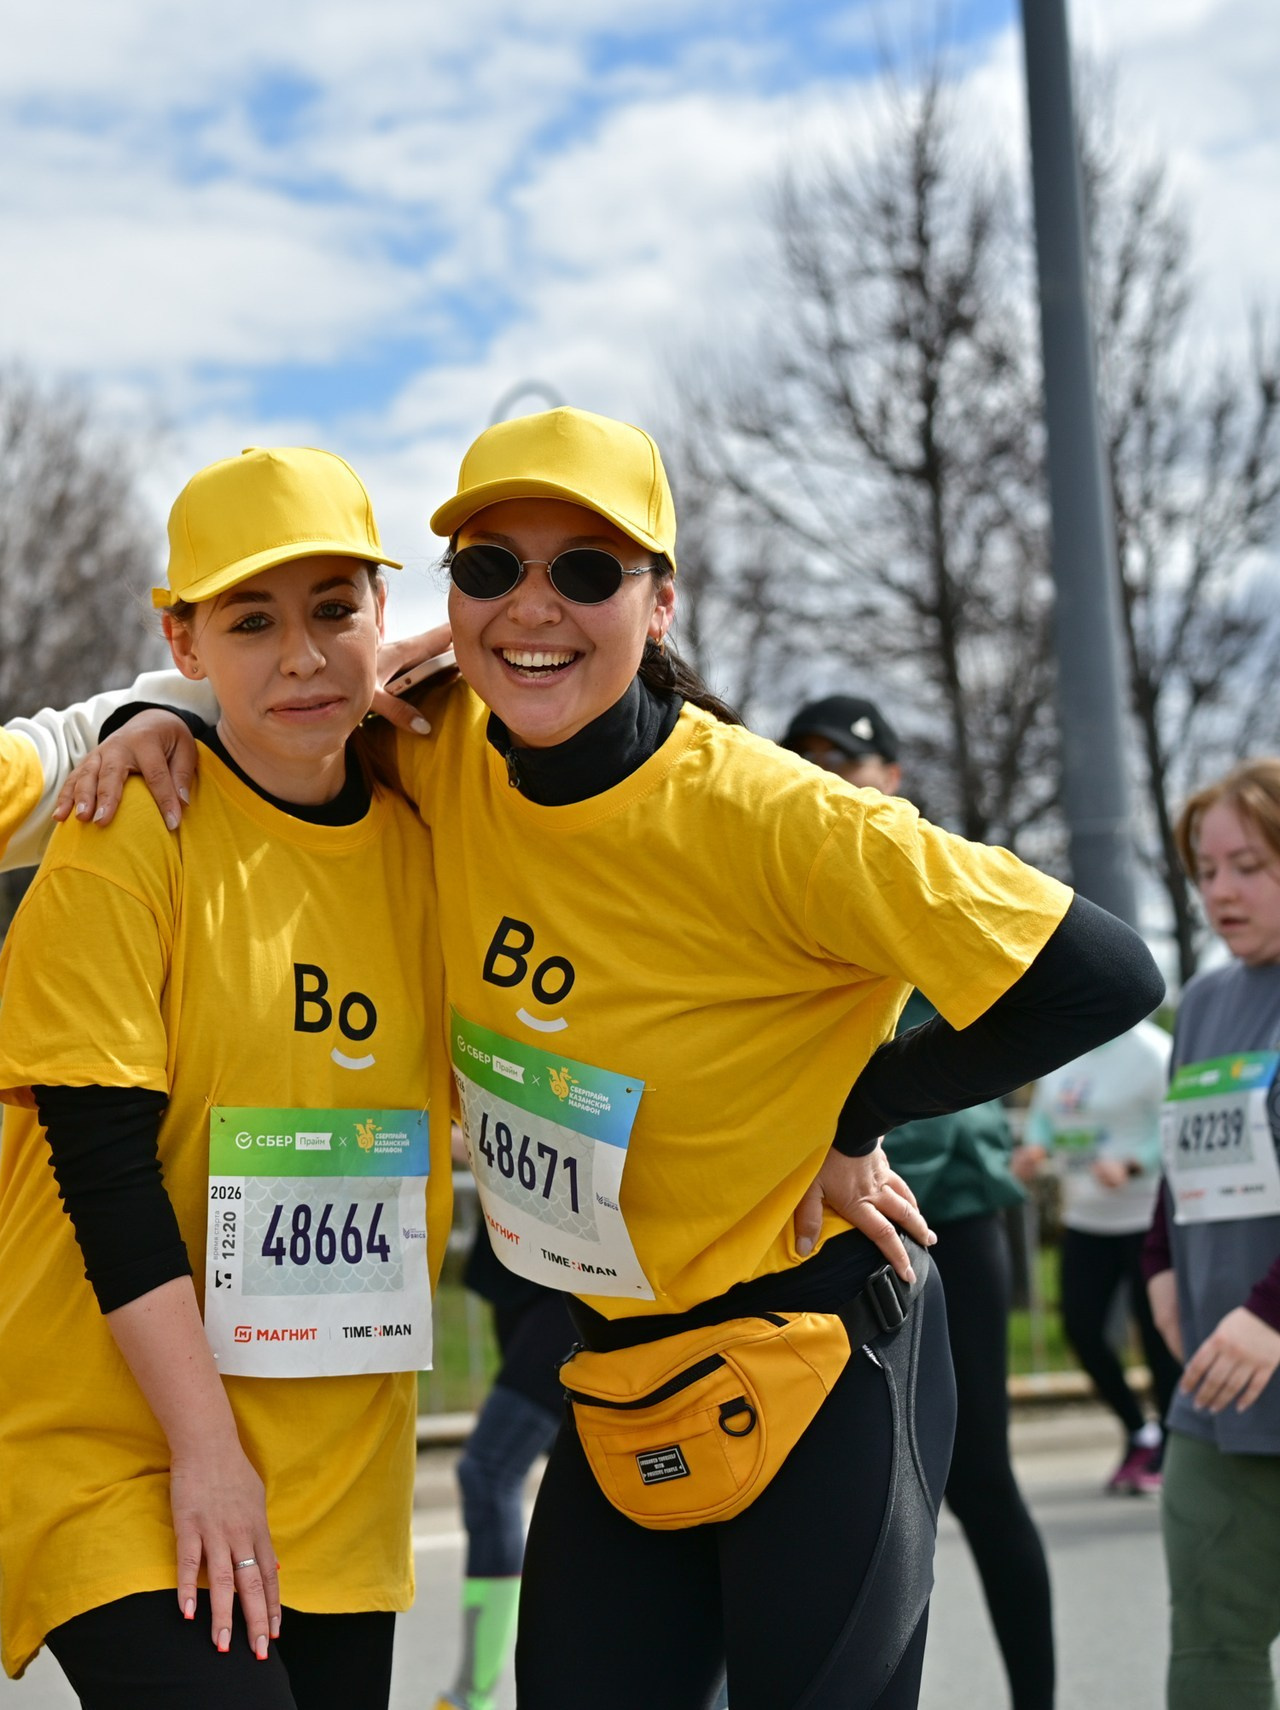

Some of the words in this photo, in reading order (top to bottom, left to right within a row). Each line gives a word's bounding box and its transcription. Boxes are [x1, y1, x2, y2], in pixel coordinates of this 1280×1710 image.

[467, 1045, 491, 1064] СБЕР
[495, 1060, 519, 1076] Прайм
[569, 1093, 611, 1111] КАЗАНСКИЙ
[570, 1085, 609, 1103] СБЕРПРАЙМ
[568, 1099, 601, 1116] МАРАФОН
[1178, 1108, 1244, 1152] 49239
[256, 1135, 293, 1147] СБЕР
[299, 1136, 326, 1146] Прайм
[479, 1112, 579, 1214] 48671
[211, 1186, 242, 1200] 2026
[222, 1211, 236, 1260] 12:20
[261, 1203, 391, 1265] 48664
[257, 1328, 317, 1341] МАГНИТ
